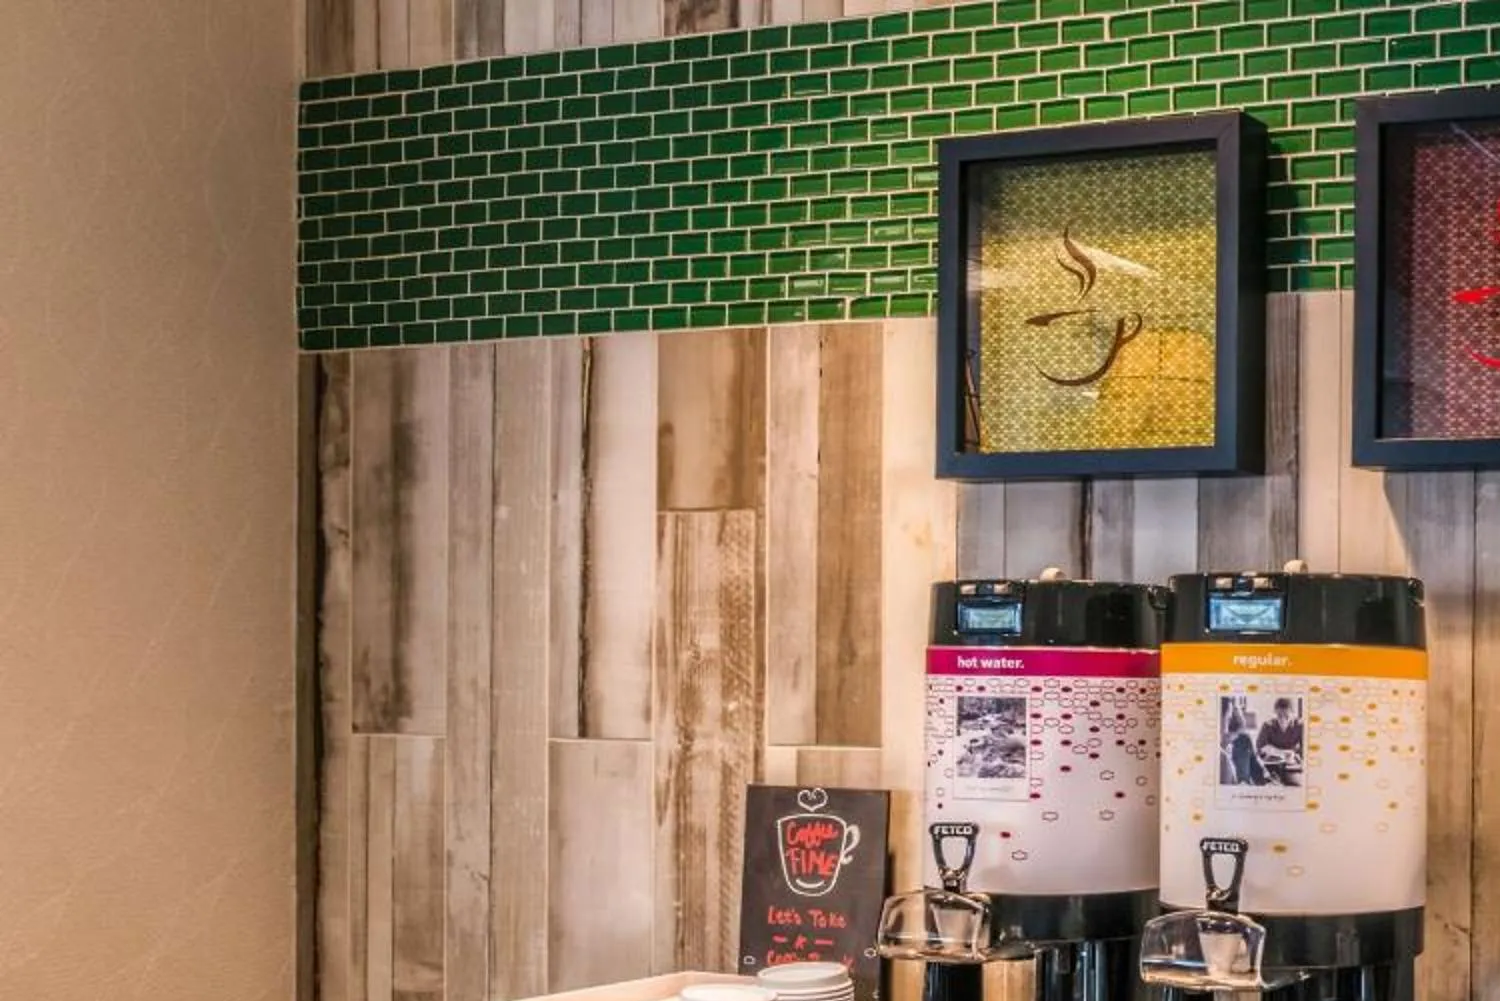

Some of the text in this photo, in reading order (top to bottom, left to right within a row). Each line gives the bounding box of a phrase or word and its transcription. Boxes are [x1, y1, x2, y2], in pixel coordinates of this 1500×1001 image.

[957, 655, 1025, 669] hot water.
[1232, 652, 1293, 669] regular.
